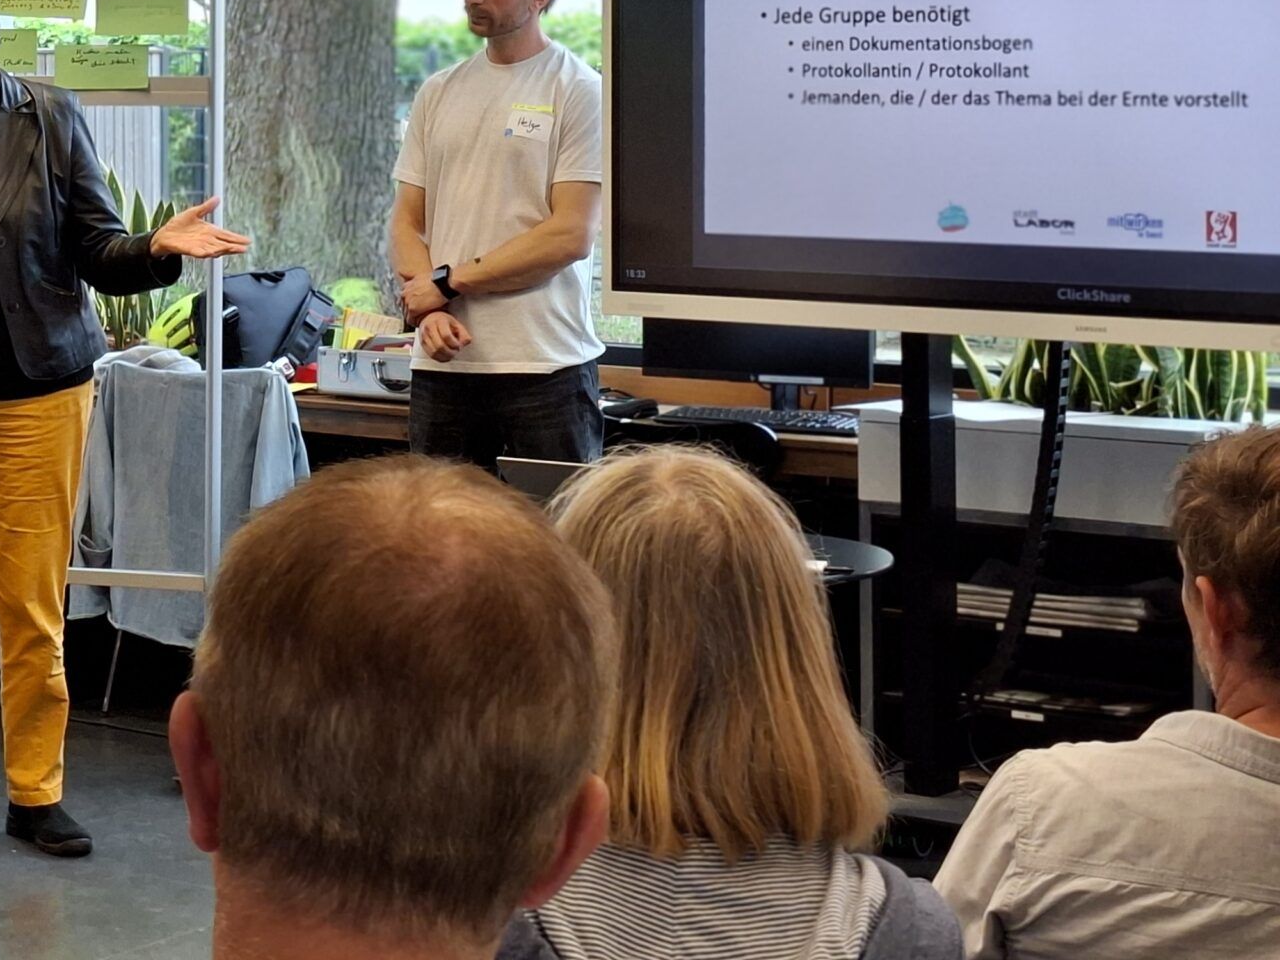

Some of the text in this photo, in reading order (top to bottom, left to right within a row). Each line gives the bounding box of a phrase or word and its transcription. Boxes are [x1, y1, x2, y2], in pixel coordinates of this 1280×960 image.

[773, 5, 971, 27] Jede Gruppe benötigt
[801, 36, 1034, 55] einen Dokumentationsbogen
[801, 62, 912, 79] Protokollantin
[929, 62, 1030, 79] Protokollant
[800, 89, 886, 108] Jemanden,
[890, 89, 914, 106] die
[931, 90, 958, 106] der
[962, 90, 990, 106] das
[996, 90, 1052, 107] Thema
[1057, 90, 1083, 107] bei
[1088, 90, 1117, 108] der
[1122, 91, 1169, 108] Ernte
[1173, 90, 1249, 109] vorstellt
[1057, 287, 1132, 303] ClickShare
